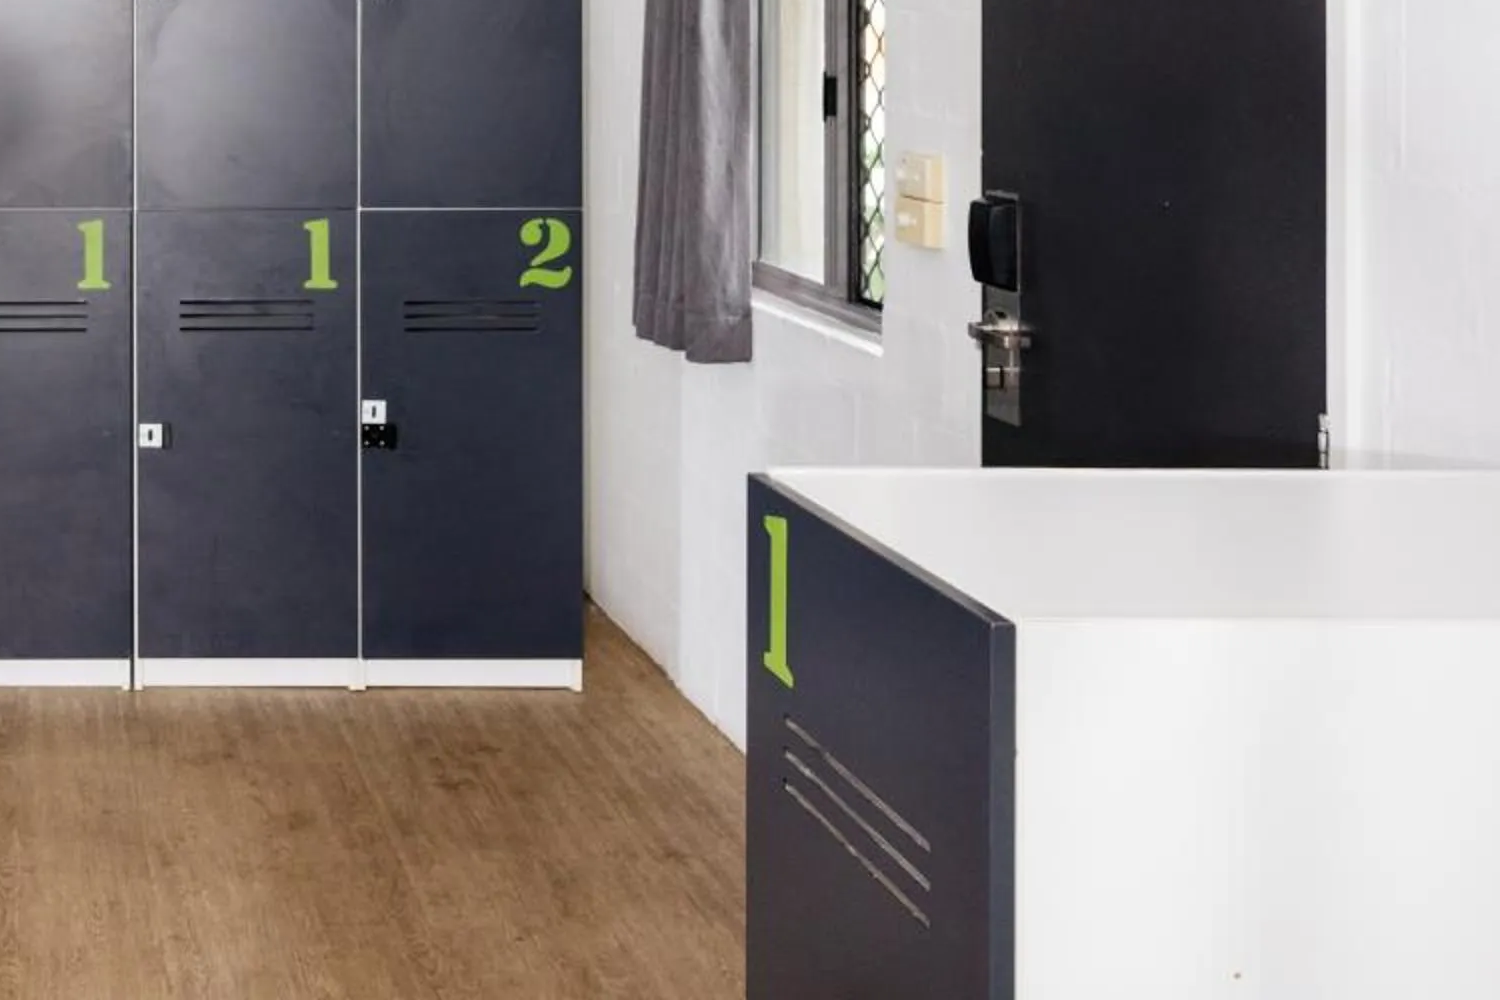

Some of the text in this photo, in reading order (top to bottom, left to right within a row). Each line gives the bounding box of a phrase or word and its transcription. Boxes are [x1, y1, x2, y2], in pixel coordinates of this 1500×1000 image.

[78, 219, 112, 291] 1
[303, 219, 338, 290] 1
[519, 218, 573, 289] 2
[763, 515, 794, 688] 1
